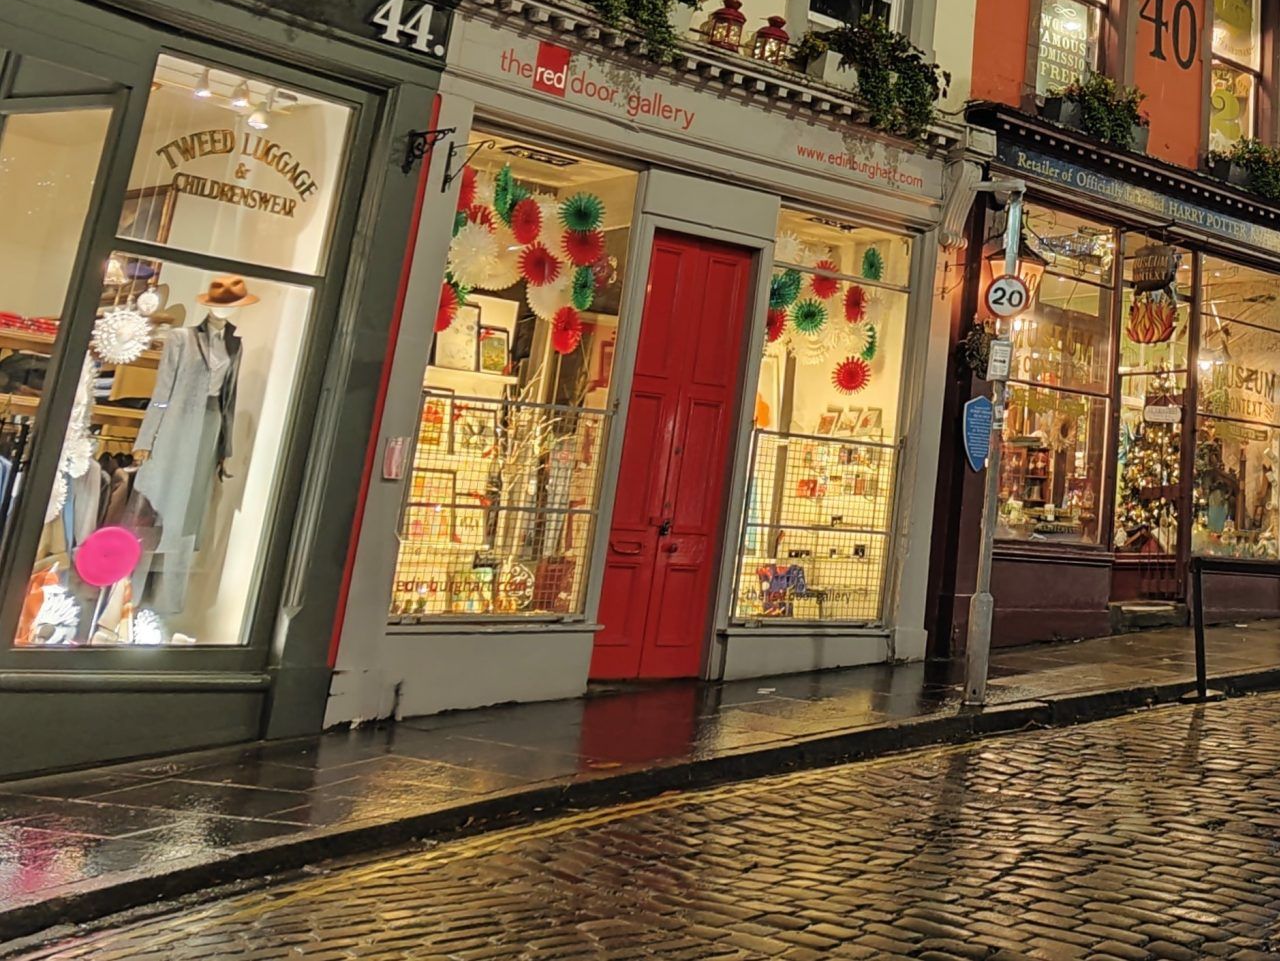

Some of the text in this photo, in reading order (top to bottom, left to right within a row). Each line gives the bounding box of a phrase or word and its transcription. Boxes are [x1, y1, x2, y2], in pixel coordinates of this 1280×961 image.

[1040, 45, 1085, 72] DMISSIO
[500, 48, 695, 130] the red door gallery
[156, 129, 318, 202] TWEED LUGGAGE
[234, 162, 251, 180] &
[797, 144, 924, 189] www.edinburghart.com
[1017, 152, 1060, 179] Retailer
[1061, 168, 1073, 182] of
[1076, 171, 1126, 201] Officially
[172, 172, 297, 217] CHILDRENSWEAR
[1168, 201, 1248, 237] HARRY POTTER
[991, 286, 1023, 308] 20
[815, 588, 851, 606] gallery
